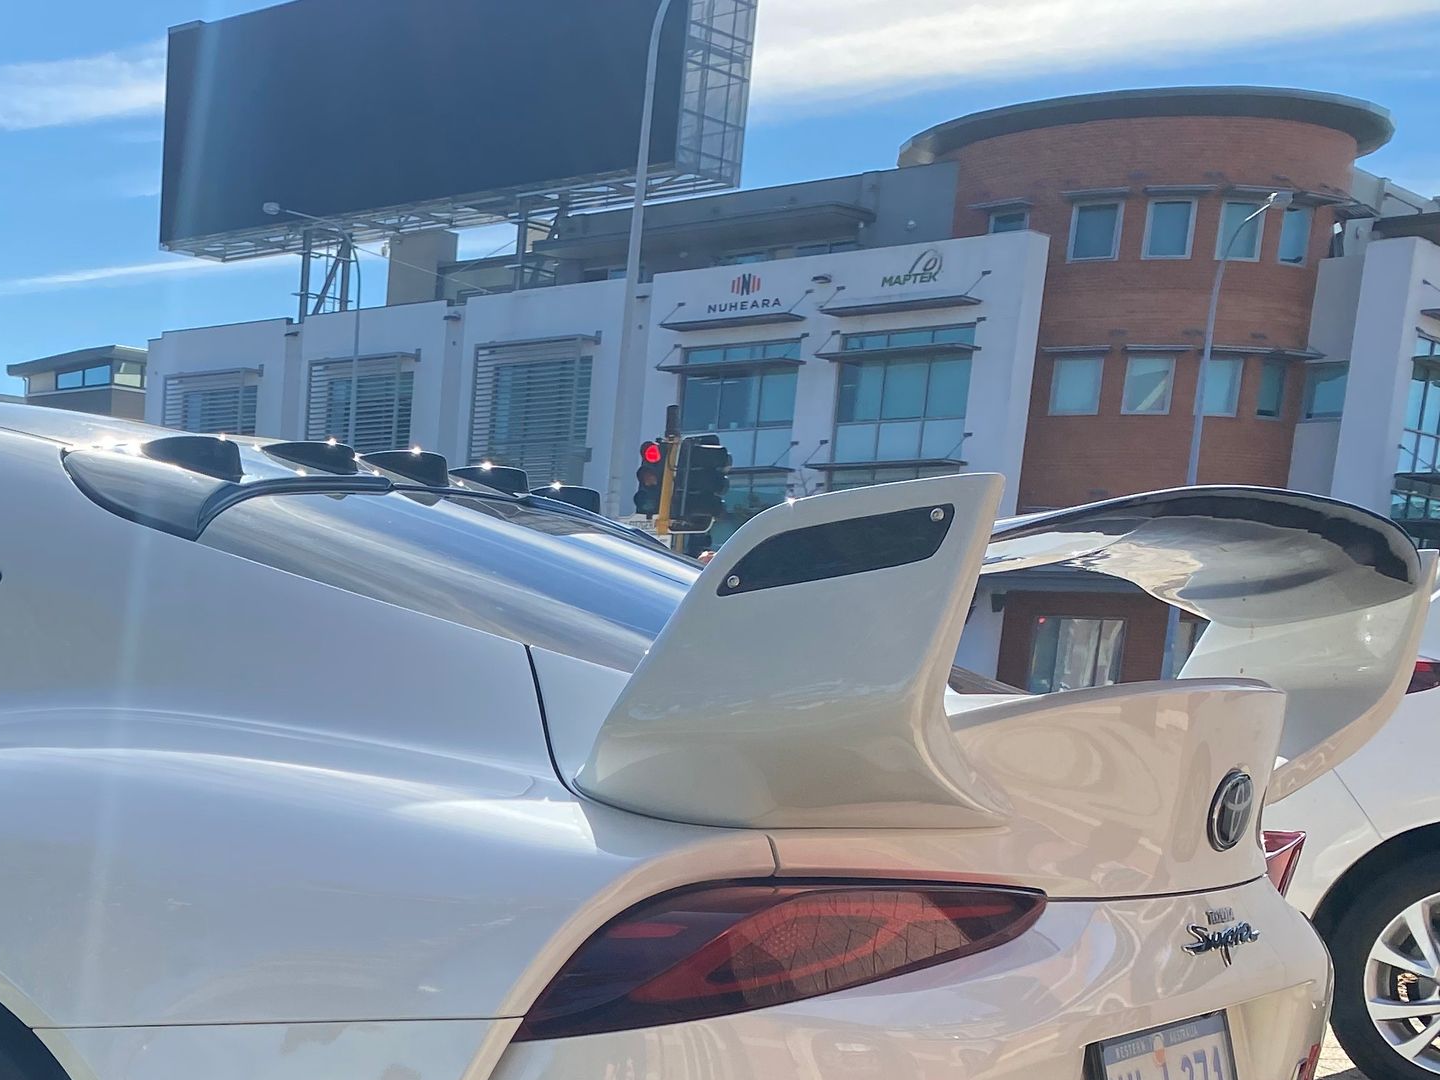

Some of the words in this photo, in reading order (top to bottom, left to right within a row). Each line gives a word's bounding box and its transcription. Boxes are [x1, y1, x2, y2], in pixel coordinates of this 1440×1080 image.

[881, 271, 937, 287] MAPTEK
[707, 298, 782, 313] NUHEARA
[1181, 920, 1260, 967] Supra
